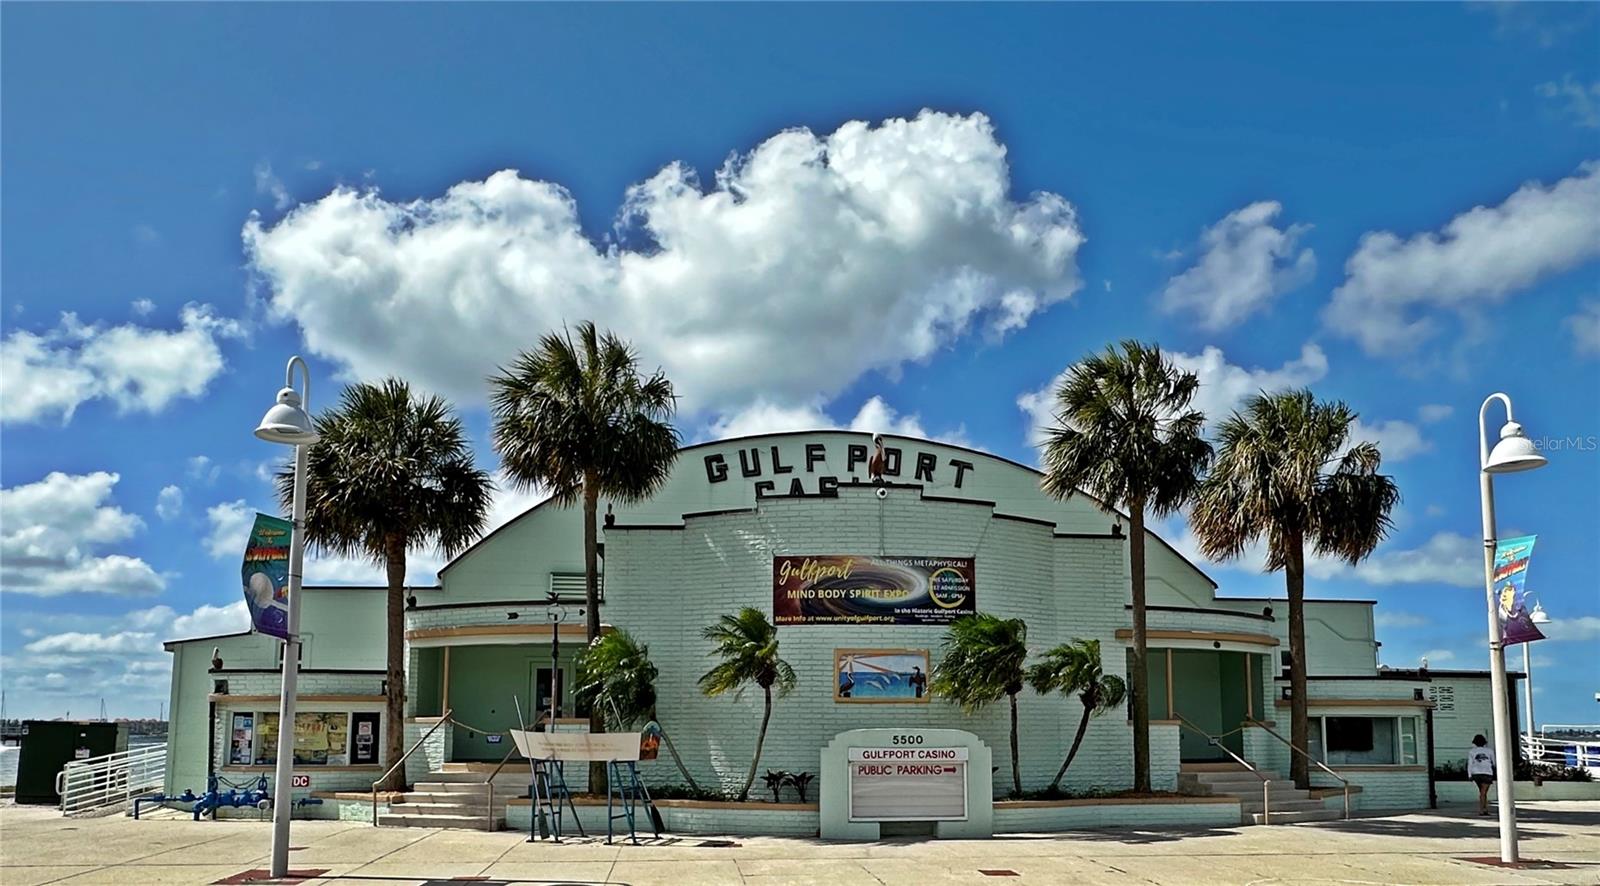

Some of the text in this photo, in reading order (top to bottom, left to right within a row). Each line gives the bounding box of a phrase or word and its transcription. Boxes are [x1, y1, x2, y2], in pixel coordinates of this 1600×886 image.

[704, 443, 974, 488] GULFPORT
[754, 477, 860, 498] CAS
[886, 559, 913, 567] THINGS
[914, 560, 968, 568] METAPHYSICAL!
[779, 558, 856, 586] Gulfport
[787, 589, 909, 599] MIND BODY SPIRIT EXPO
[892, 735, 924, 745] 5500
[863, 750, 956, 759] GULFPORT CASINO
[858, 765, 943, 775] PUBLIC PARKING
[293, 776, 308, 787] DC
